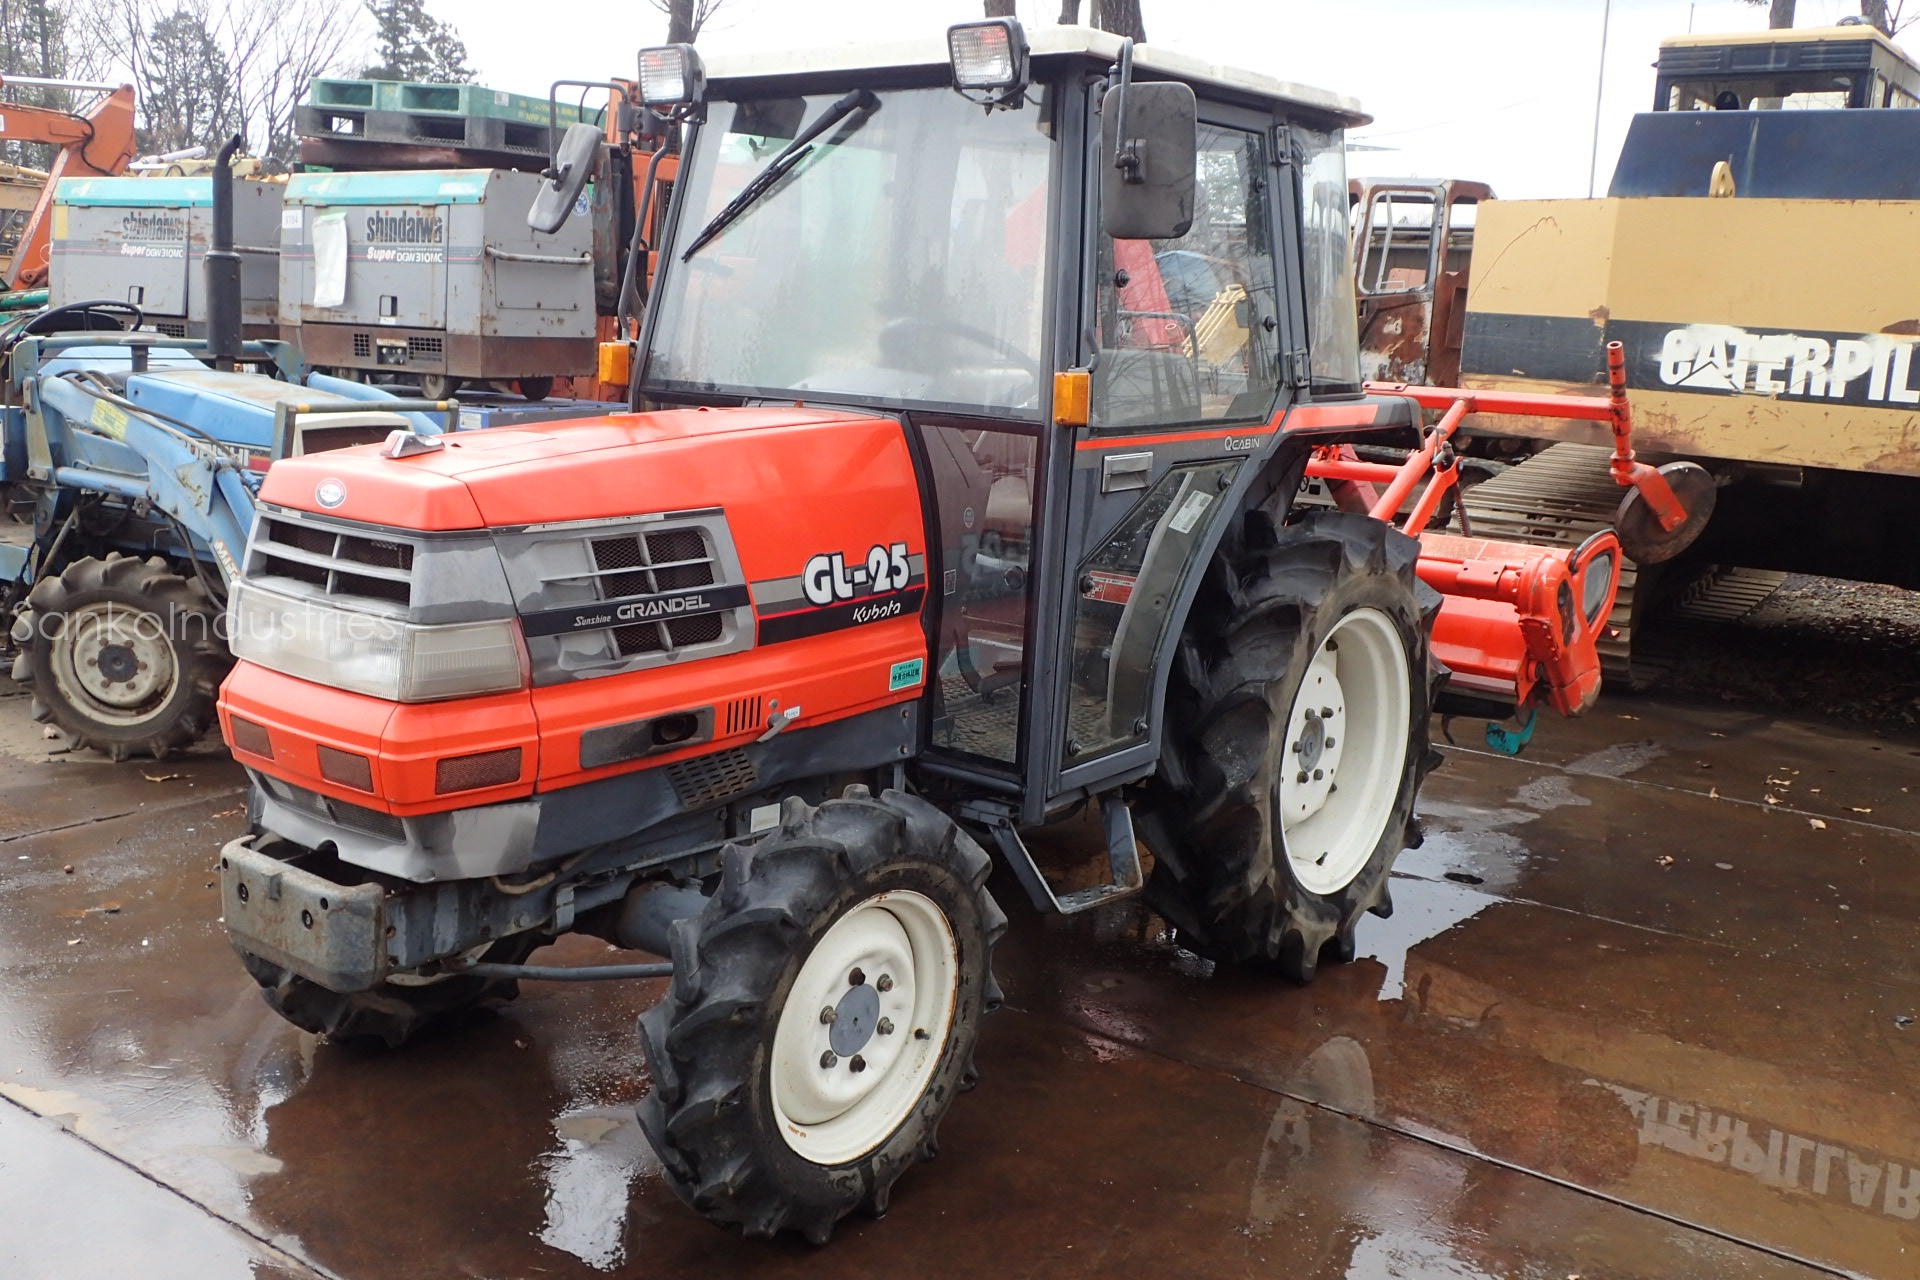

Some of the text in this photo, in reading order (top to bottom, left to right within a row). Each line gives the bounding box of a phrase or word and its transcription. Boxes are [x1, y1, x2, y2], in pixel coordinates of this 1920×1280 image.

[122, 211, 184, 240] shindaiwa
[366, 209, 443, 243] shindaiwa
[121, 242, 147, 257] Super
[367, 246, 397, 262] Super
[397, 252, 443, 263] DGW310MC
[1660, 325, 1919, 403] CATERPIL
[802, 541, 911, 607] GL-25
[574, 594, 711, 628] Sunshine GRANDEL
[852, 600, 901, 623] Kubota
